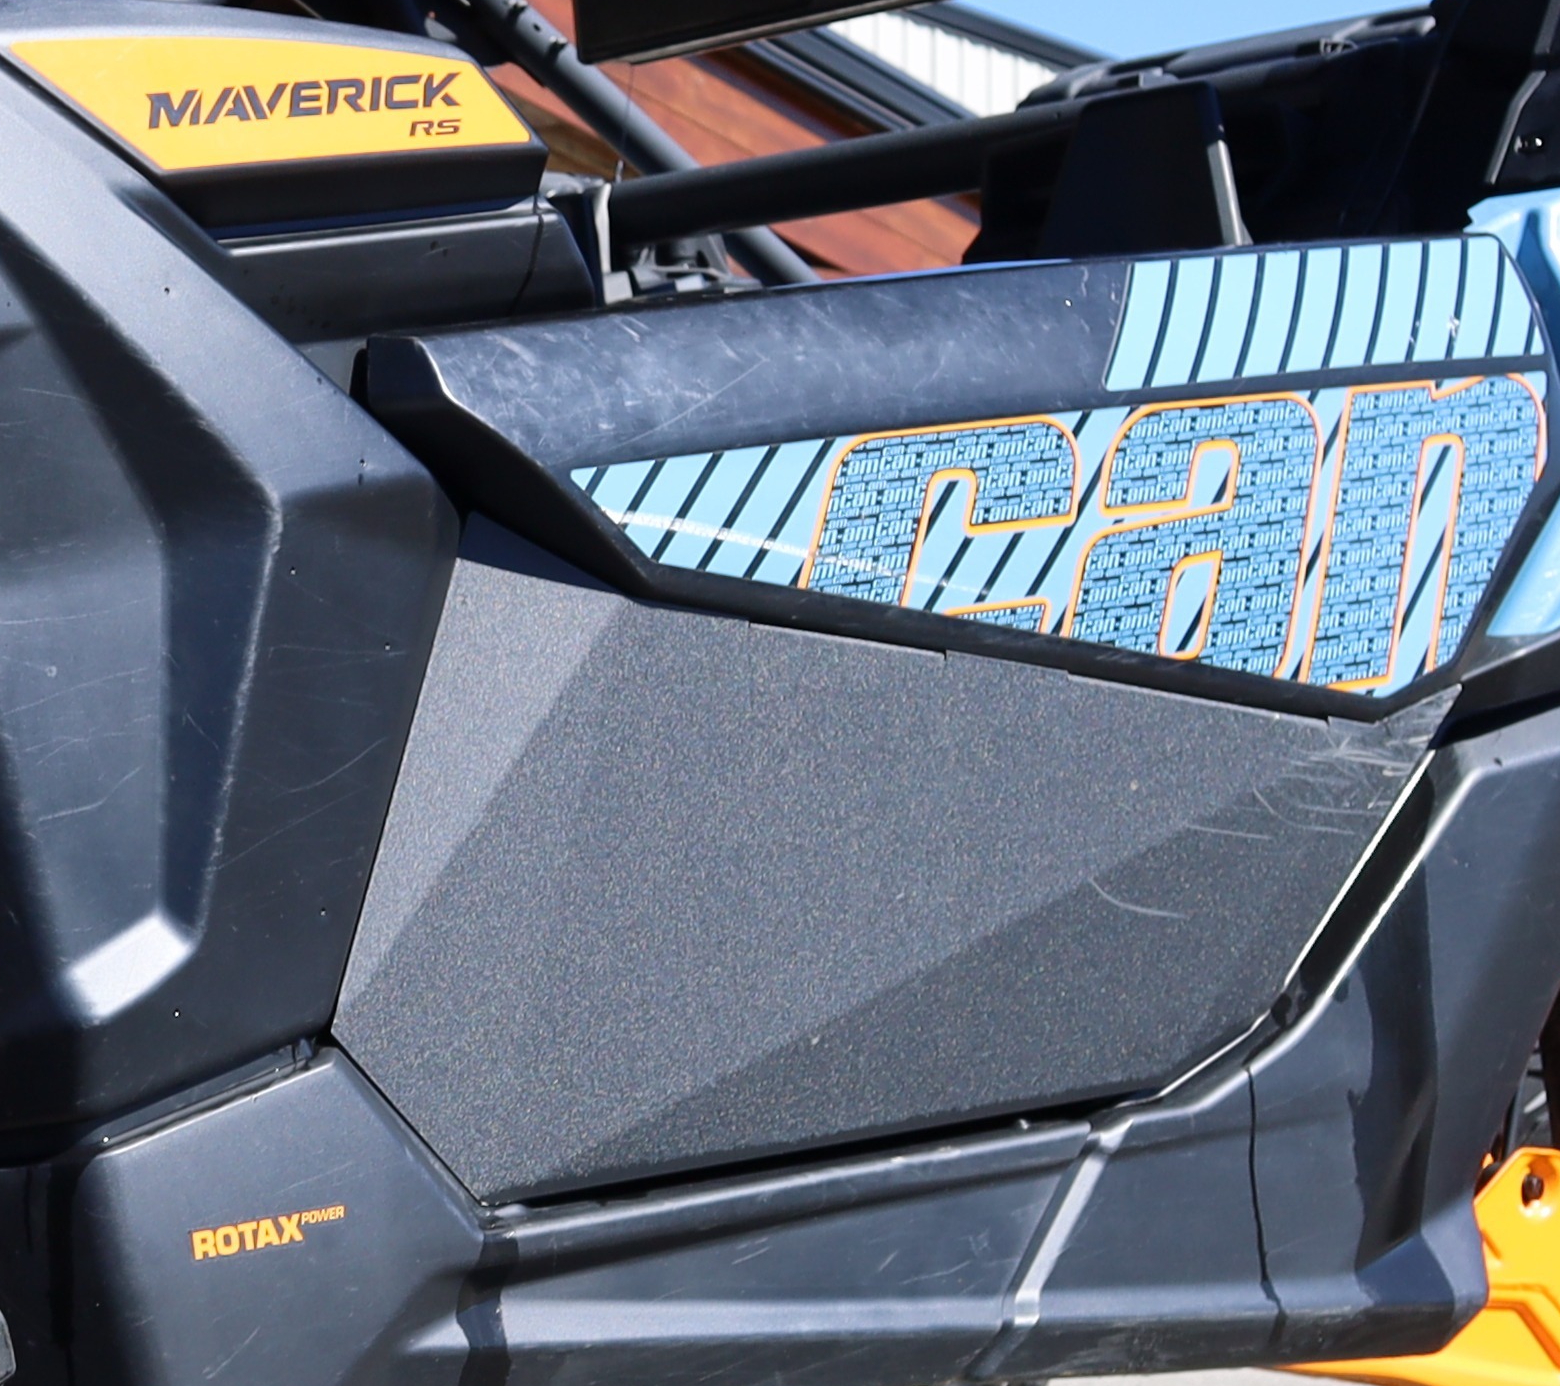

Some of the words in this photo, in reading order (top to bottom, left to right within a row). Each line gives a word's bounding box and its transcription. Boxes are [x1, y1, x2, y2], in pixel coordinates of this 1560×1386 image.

[146, 72, 462, 130] MAVERICK
[408, 119, 462, 137] RS
[191, 1212, 304, 1261] ROTAX
[300, 1204, 346, 1226] POWER
